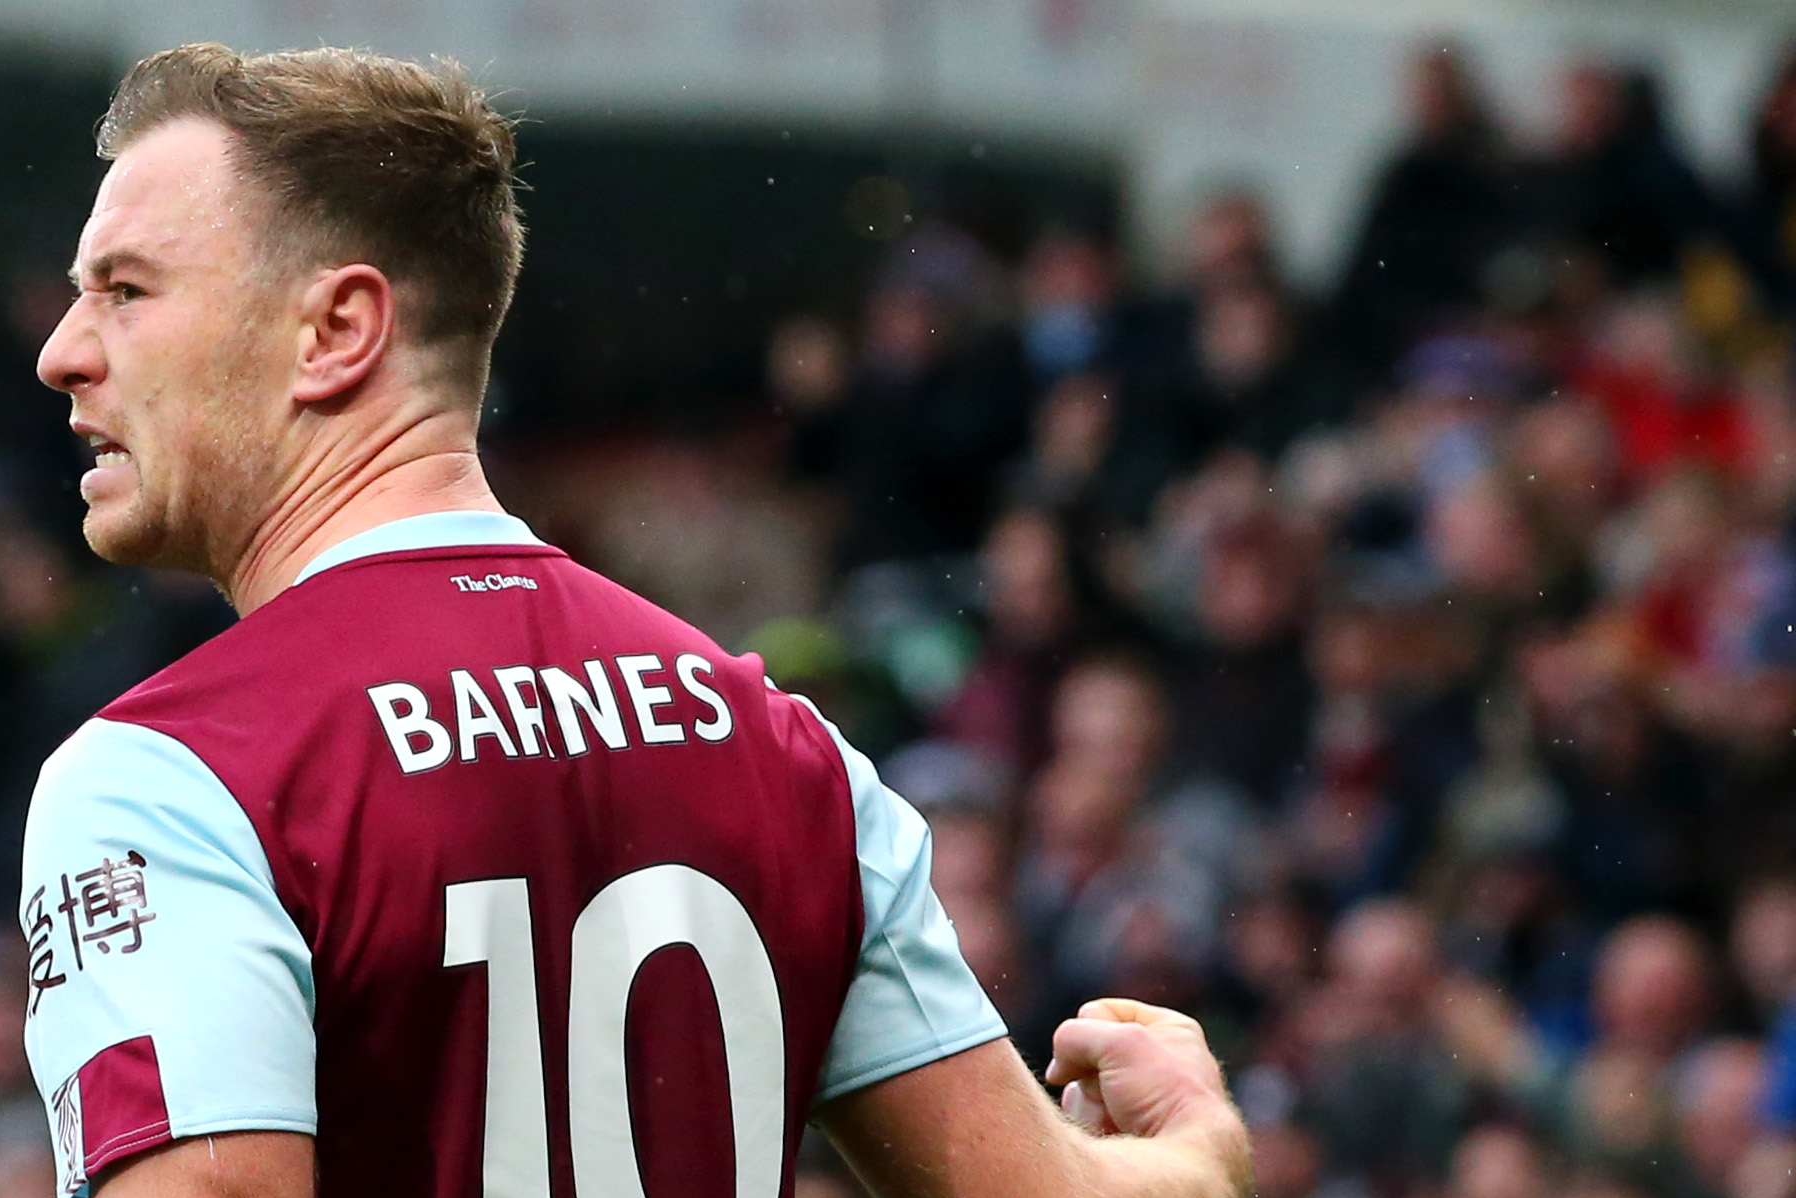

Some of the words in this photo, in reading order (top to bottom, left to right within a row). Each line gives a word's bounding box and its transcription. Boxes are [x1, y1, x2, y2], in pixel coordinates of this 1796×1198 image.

[450, 575, 487, 592] The
[485, 573, 538, 591] Clarts
[366, 653, 734, 774] BARNES
